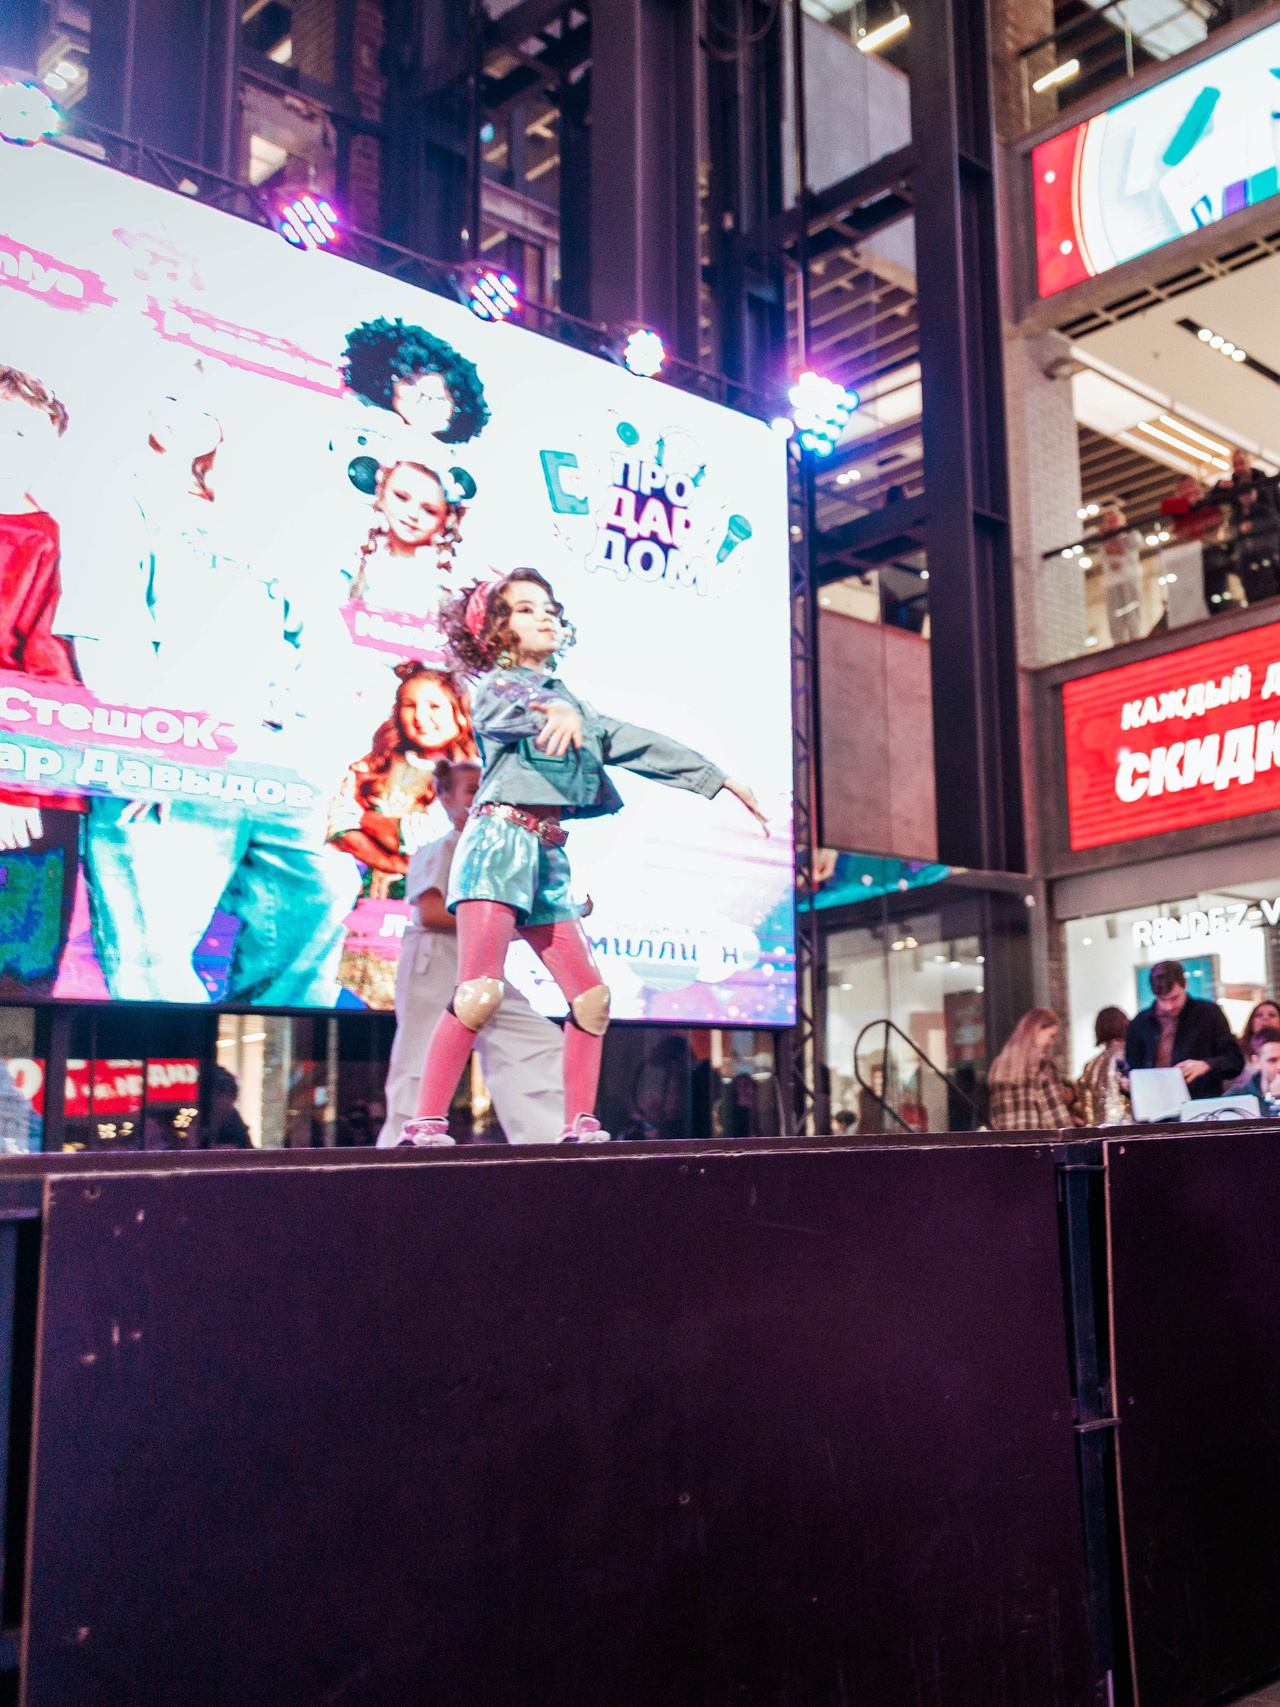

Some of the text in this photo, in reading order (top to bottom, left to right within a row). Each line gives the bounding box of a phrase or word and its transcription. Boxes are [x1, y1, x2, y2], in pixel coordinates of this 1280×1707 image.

[610, 452, 696, 507] ПРО
[596, 485, 694, 547] ДАР
[584, 528, 707, 597] ДОМ
[1121, 663, 1252, 731] КАЖДЫЙ
[76, 750, 313, 807] Давыдов
[588, 935, 740, 965] МИЛЛИН
